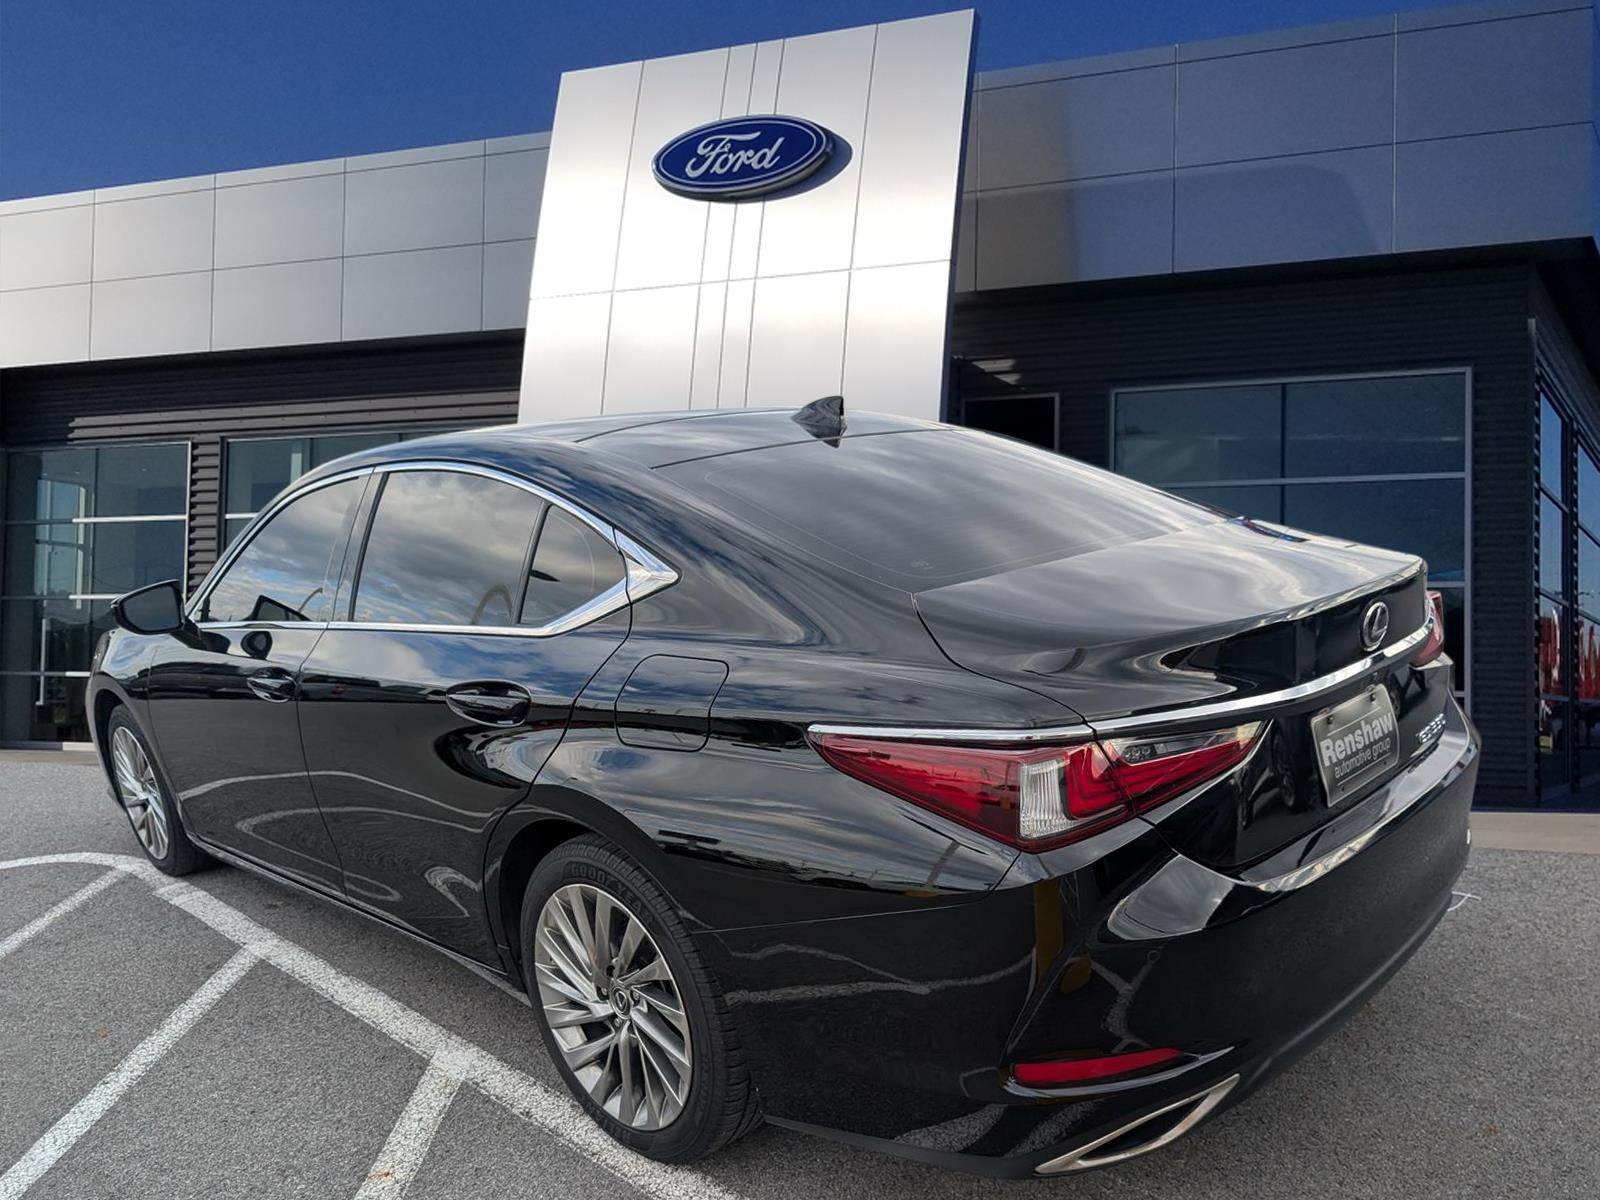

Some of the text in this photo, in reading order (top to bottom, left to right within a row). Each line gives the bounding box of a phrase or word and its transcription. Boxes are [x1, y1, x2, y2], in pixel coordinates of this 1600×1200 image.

[685, 131, 784, 178] Ford
[1320, 712, 1393, 767] Renshaw
[1334, 737, 1392, 778] automotive group
